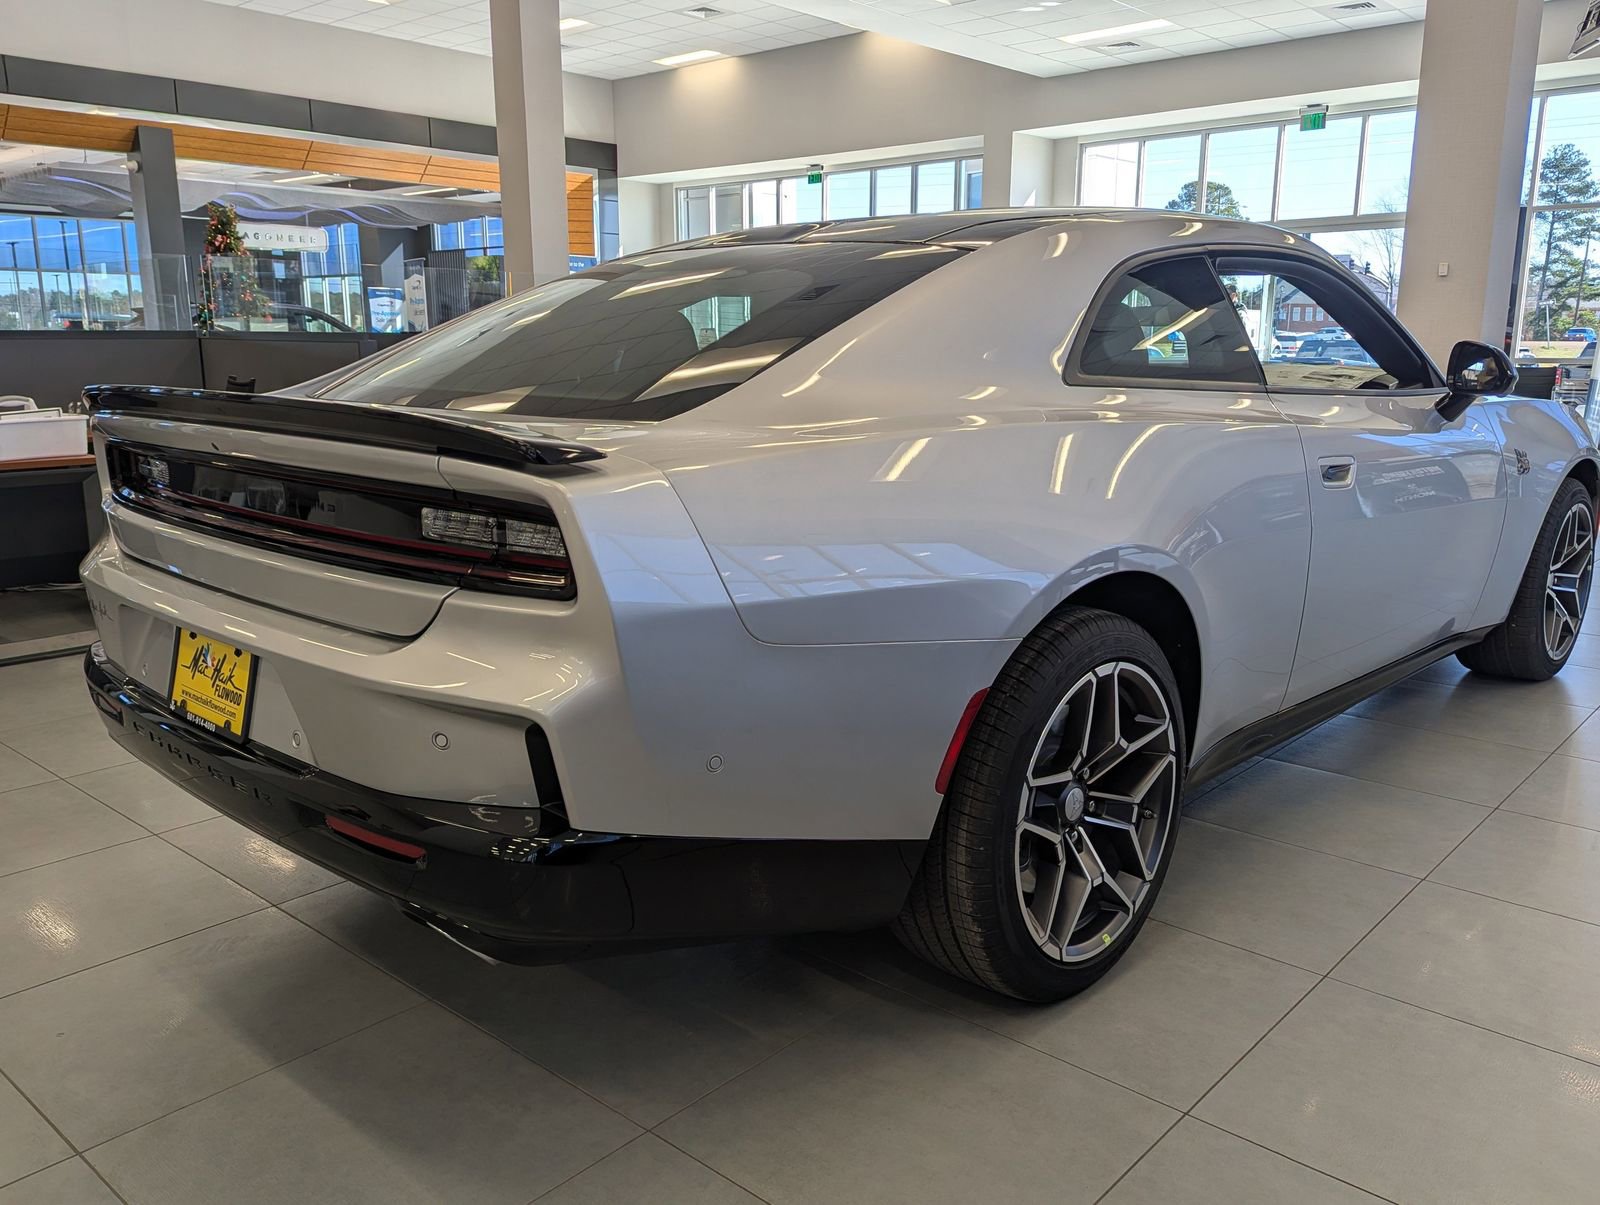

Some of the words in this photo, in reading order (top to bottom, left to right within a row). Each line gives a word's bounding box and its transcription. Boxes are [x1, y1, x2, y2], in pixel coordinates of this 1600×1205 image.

[243, 231, 316, 244] AGONEER
[181, 689, 236, 719] www.machaikflowood.com
[214, 684, 242, 706] FLOWOOD
